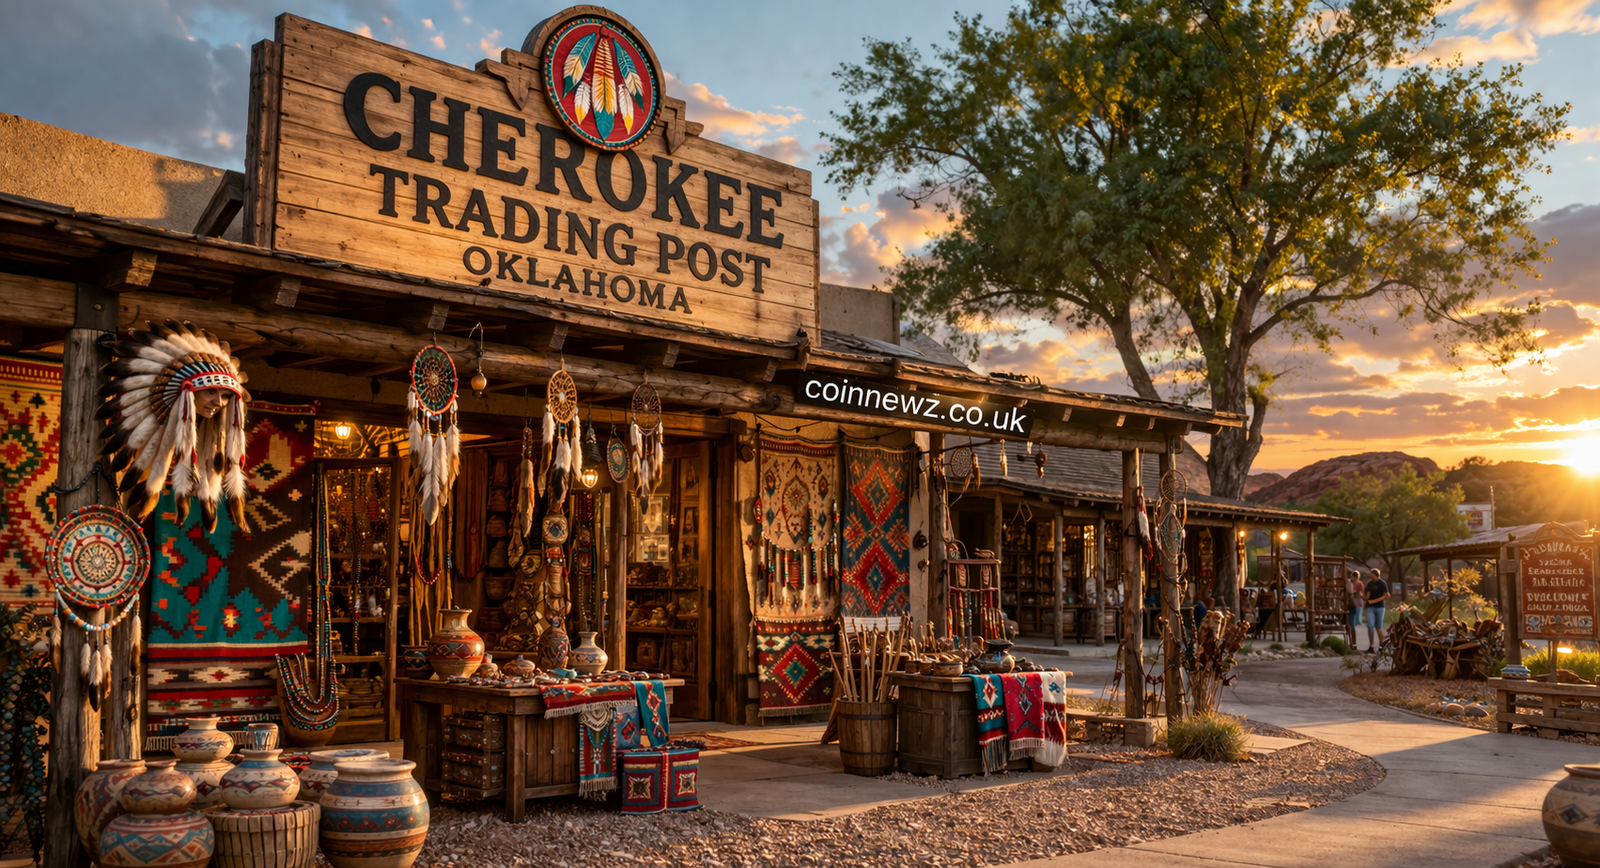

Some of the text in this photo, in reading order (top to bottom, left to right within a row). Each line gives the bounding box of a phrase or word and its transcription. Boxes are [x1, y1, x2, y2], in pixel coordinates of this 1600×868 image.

[344, 72, 785, 249] CHEROKEE
[370, 164, 771, 294] TRADING POST
[462, 246, 693, 314] OKLAHOMA
